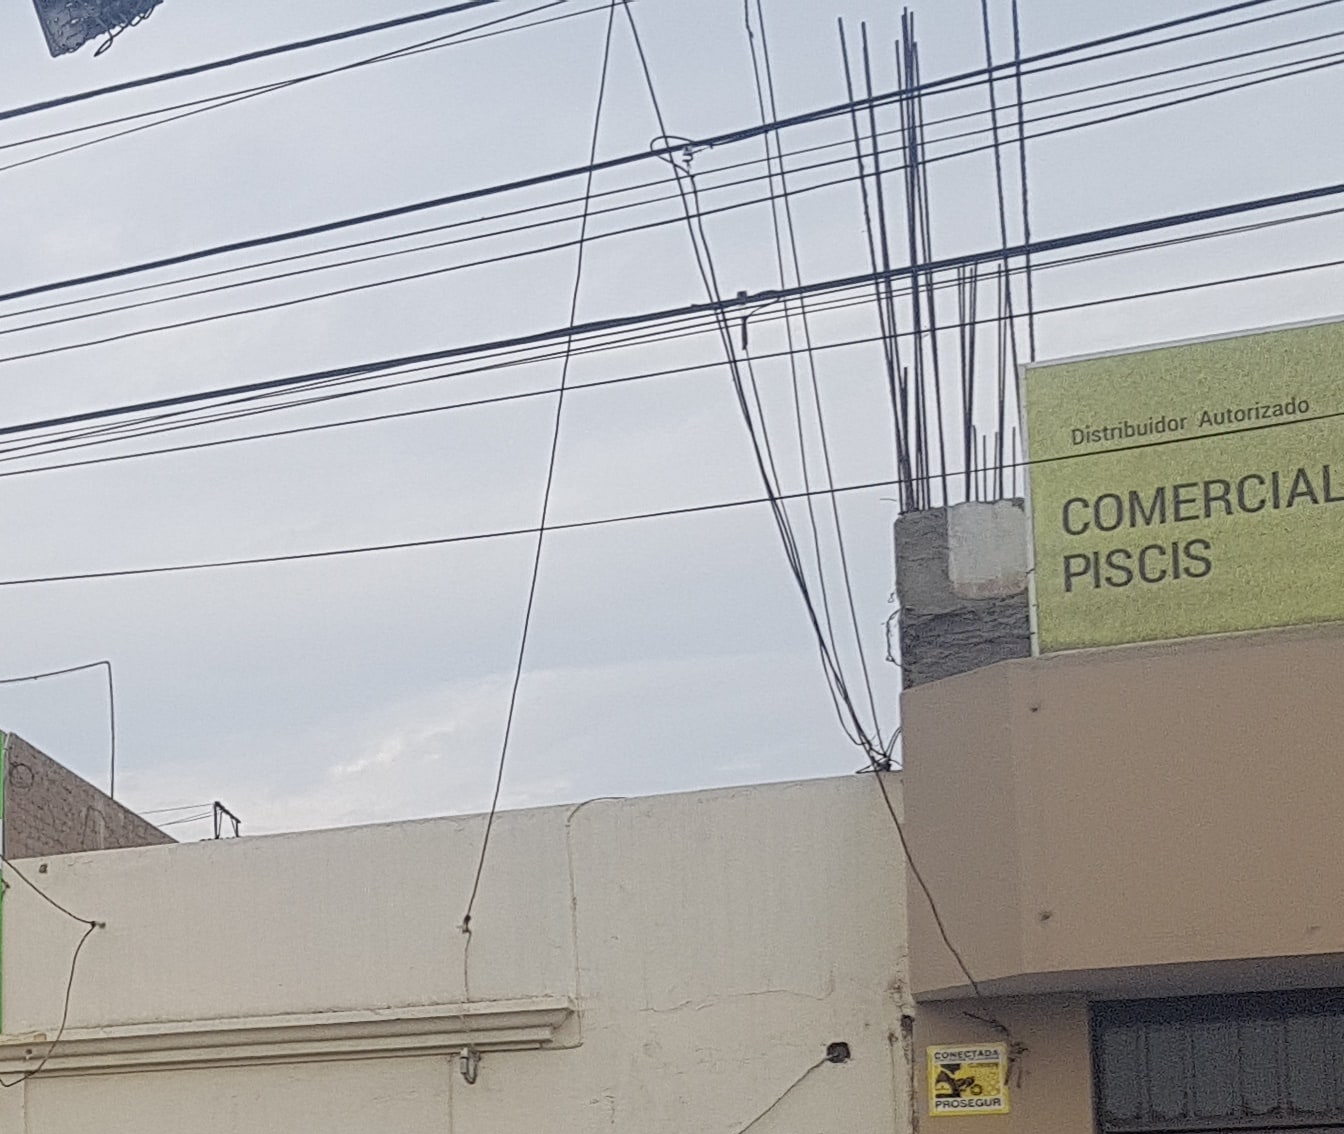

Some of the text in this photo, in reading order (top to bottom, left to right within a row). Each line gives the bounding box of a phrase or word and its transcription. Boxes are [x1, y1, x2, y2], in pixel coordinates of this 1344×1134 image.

[1072, 398, 1310, 446] Distribuidor Autorizado
[1062, 465, 1344, 536] COMERCIAL
[1063, 538, 1212, 593] PISCIS
[934, 1049, 999, 1060] CONECTADA
[936, 1098, 1001, 1108] PROSEGUR
